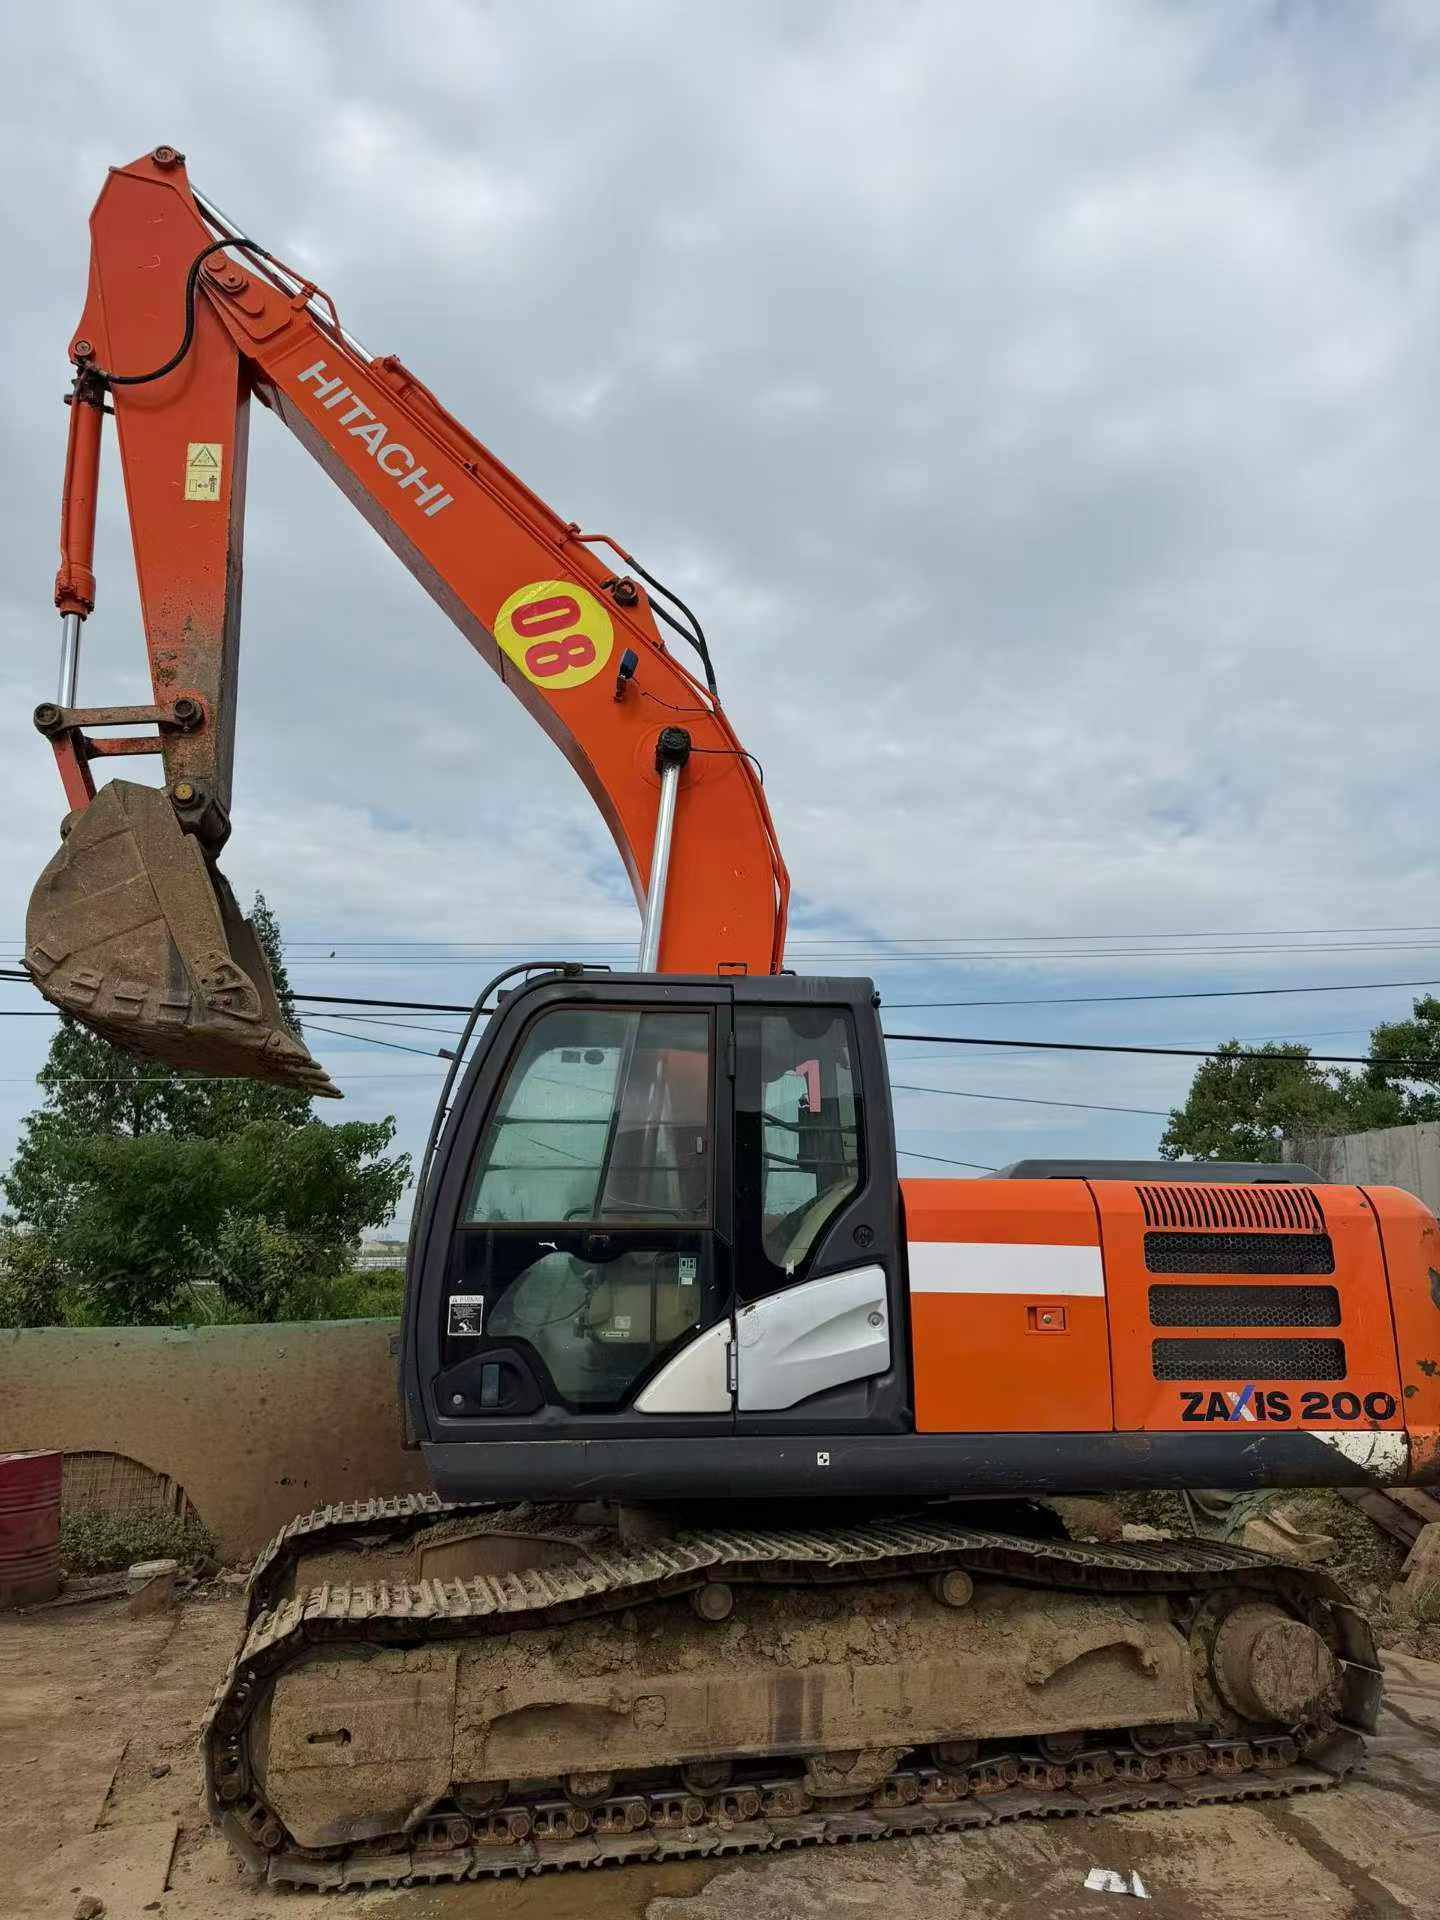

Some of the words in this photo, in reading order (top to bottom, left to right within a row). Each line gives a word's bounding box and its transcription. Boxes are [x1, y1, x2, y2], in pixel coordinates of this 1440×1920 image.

[297, 360, 455, 518] HITACHI
[1179, 1385, 1292, 1422] ZAXIS
[1301, 1391, 1396, 1421] 200
